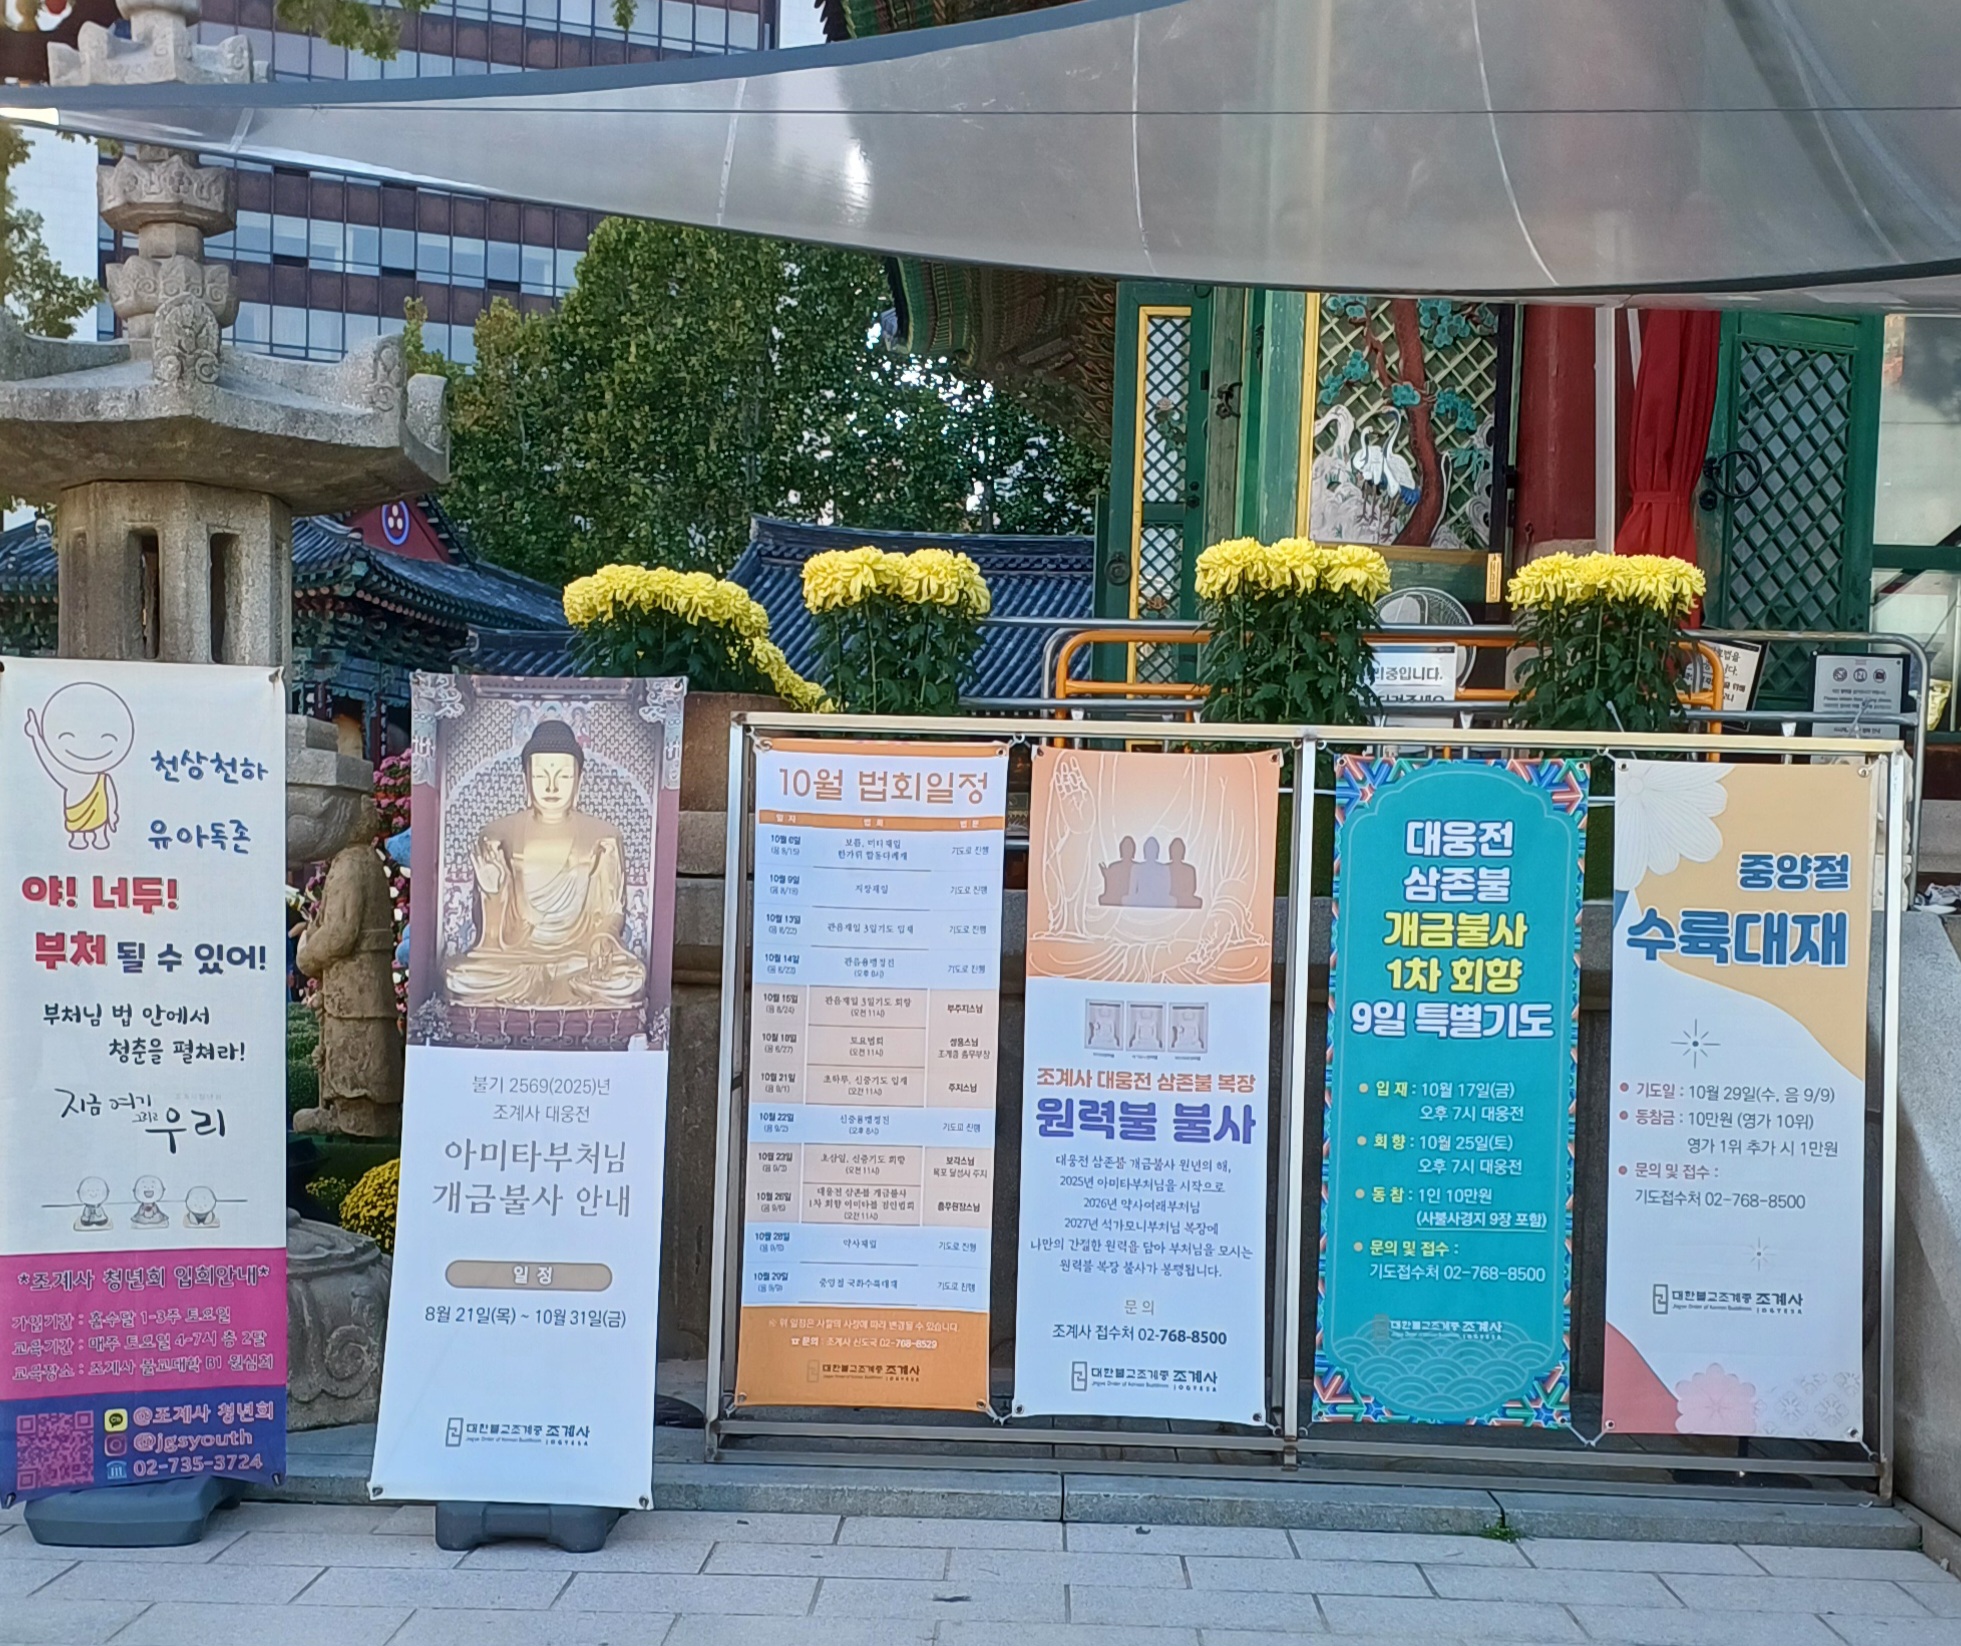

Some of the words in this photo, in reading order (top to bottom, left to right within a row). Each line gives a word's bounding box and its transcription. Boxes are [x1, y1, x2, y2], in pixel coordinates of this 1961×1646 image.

[151, 750, 268, 783] 천상천하
[779, 769, 843, 800] 10월
[859, 771, 988, 804] 법회일정
[148, 820, 251, 854] 유아독존
[1405, 820, 1514, 857] 대웅전
[1739, 853, 1850, 890] 중양절
[1403, 866, 1511, 902] 삼존불
[22, 876, 77, 908] 야!
[93, 876, 179, 914] 너두!
[1384, 911, 1528, 948] 개금불사
[1627, 908, 1848, 967] 수륙대재
[35, 932, 107, 969] 부처
[118, 942, 145, 973] 될
[157, 944, 182, 971] 수
[195, 944, 267, 975] 있어!
[1386, 958, 1441, 992] 1차
[1449, 958, 1523, 994] 회향
[43, 1003, 102, 1026] 부처님
[112, 1003, 132, 1026] 법
[143, 1005, 210, 1026] 안에서
[1351, 1001, 1406, 1037] 9일
[1415, 1002, 1555, 1039] 특별기도
[109, 1038, 163, 1064] 청춘을
[173, 1040, 245, 1064] 펼쳐라!
[472, 1075, 505, 1094] 불기
[510, 1076, 611, 1096] 2569(2025)년
[779, 1073, 795, 1082] 21일
[1037, 1068, 1092, 1087] 조계사
[1098, 1070, 1151, 1090] 대웅전
[1157, 1073, 1212, 1092] 삼존불
[1218, 1074, 1256, 1093] 복장
[1422, 1083, 1453, 1097] 10월
[1458, 1083, 1515, 1099] 17일(금)
[1636, 1083, 1675, 1099] 기도일
[1689, 1085, 1719, 1101] 10월
[1784, 1087, 1800, 1103] 음
[1804, 1088, 1835, 1103] 9/9)
[55, 1088, 102, 1118] 지금
[109, 1093, 151, 1109] 여기
[493, 1105, 540, 1122] 조계사
[545, 1105, 590, 1124] 대웅전
[778, 1113, 794, 1122] 22일
[1036, 1098, 1157, 1141] 원력불
[1173, 1103, 1256, 1144] 불사
[1420, 1106, 1448, 1121] 오후
[1453, 1108, 1475, 1122] 7시
[1481, 1106, 1524, 1122] 대웅전
[1635, 1110, 1675, 1126] 동참금
[1689, 1112, 1733, 1128] 10만원
[1737, 1113, 1771, 1129] (영가
[1777, 1114, 1814, 1130] 10위)
[145, 1108, 226, 1154] 우리
[1420, 1136, 1451, 1151] 10월
[1456, 1137, 1512, 1151] 25일(토)
[1688, 1138, 1715, 1154] 영가
[1720, 1139, 1742, 1155] 1위
[1746, 1140, 1776, 1156] 추가
[1780, 1141, 1794, 1156] 시
[1801, 1141, 1838, 1157] 1만원
[445, 1138, 627, 1175] 아미타부처님
[1056, 1155, 1089, 1170] 대웅전
[1092, 1156, 1125, 1169] 삼존불
[1130, 1158, 1175, 1171] 개금불사
[1179, 1159, 1212, 1172] 원년의
[1418, 1159, 1446, 1174] 오후
[1452, 1160, 1474, 1174] 7시
[1480, 1160, 1523, 1175] 대웅전
[1635, 1163, 1661, 1177] 문의
[1666, 1163, 1678, 1179] 및
[1683, 1164, 1709, 1180] 접수
[1060, 1176, 1094, 1188] 2025년
[1098, 1178, 1177, 1193] 아미타부처님을
[1180, 1181, 1225, 1193] 시작으로
[433, 1182, 563, 1217] 개금불사
[577, 1185, 631, 1218] 안내
[1083, 1198, 1117, 1210] 2026년
[1121, 1200, 1200, 1213] 약사여래부처님
[1419, 1189, 1440, 1204] 1인
[1446, 1189, 1492, 1204] 10만원
[1635, 1190, 1701, 1206] 기도접수처
[1705, 1192, 1806, 1209] 02-768-8500
[1064, 1218, 1098, 1231] 2027년
[1102, 1219, 1180, 1234] 석가모니부처님
[1184, 1222, 1218, 1235] 복장에
[1416, 1212, 1486, 1227] (사불사경지
[1490, 1212, 1511, 1227] 9장
[1515, 1213, 1547, 1228] 포함)
[1031, 1238, 1064, 1250] 나만의
[1069, 1239, 1102, 1252] 간절한
[1105, 1240, 1138, 1253] 원력을
[1143, 1243, 1165, 1254] 담아
[1169, 1243, 1215, 1256] 부처님을
[1218, 1245, 1253, 1259] 모시는
[1370, 1241, 1397, 1256] 문의
[1402, 1241, 1415, 1256] 및
[1421, 1242, 1449, 1257] 접수
[1060, 1259, 1093, 1272] 원력불
[1097, 1260, 1119, 1273] 복장
[1123, 1263, 1157, 1275] 불사가
[1370, 1264, 1439, 1280] 기도접수처
[1444, 1266, 1546, 1282] 02-768-8500
[103, 1267, 166, 1290] 청년회
[1672, 1290, 1752, 1303] 대한불교조계종
[1756, 1293, 1803, 1306] 조계사
[12, 1315, 75, 1332] 가입기간
[141, 1309, 181, 1325] 1-3주
[185, 1307, 231, 1324] 토요일
[425, 1306, 451, 1323] 8월
[455, 1307, 516, 1326] 21일(목)
[535, 1308, 566, 1326] 10월
[570, 1309, 626, 1328] 31일(금)
[12, 1340, 75, 1356] 교육기간
[89, 1337, 121, 1352] 매주
[124, 1334, 171, 1351] 토요일
[175, 1331, 216, 1347] 4-7시
[221, 1331, 237, 1347] 총
[242, 1330, 266, 1347] 2달
[1052, 1324, 1091, 1340] 조계사
[1095, 1326, 1134, 1341] 접수처
[1138, 1329, 1227, 1345] 02-768-8500
[12, 1364, 75, 1382] 교육장소
[88, 1361, 135, 1376] 조계사
[140, 1356, 202, 1376] 불교대학
[206, 1358, 221, 1369] B1
[886, 1365, 920, 1375] 조계사
[1173, 1370, 1217, 1383] 조계사
[133, 1405, 210, 1427] @조계사
[218, 1402, 274, 1424] 청년회
[466, 1423, 542, 1436] 대한불교조계종
[546, 1425, 590, 1438] 조계사
[133, 1429, 253, 1454] @jgsyouth
[133, 1454, 262, 1477] 02-735-3724
